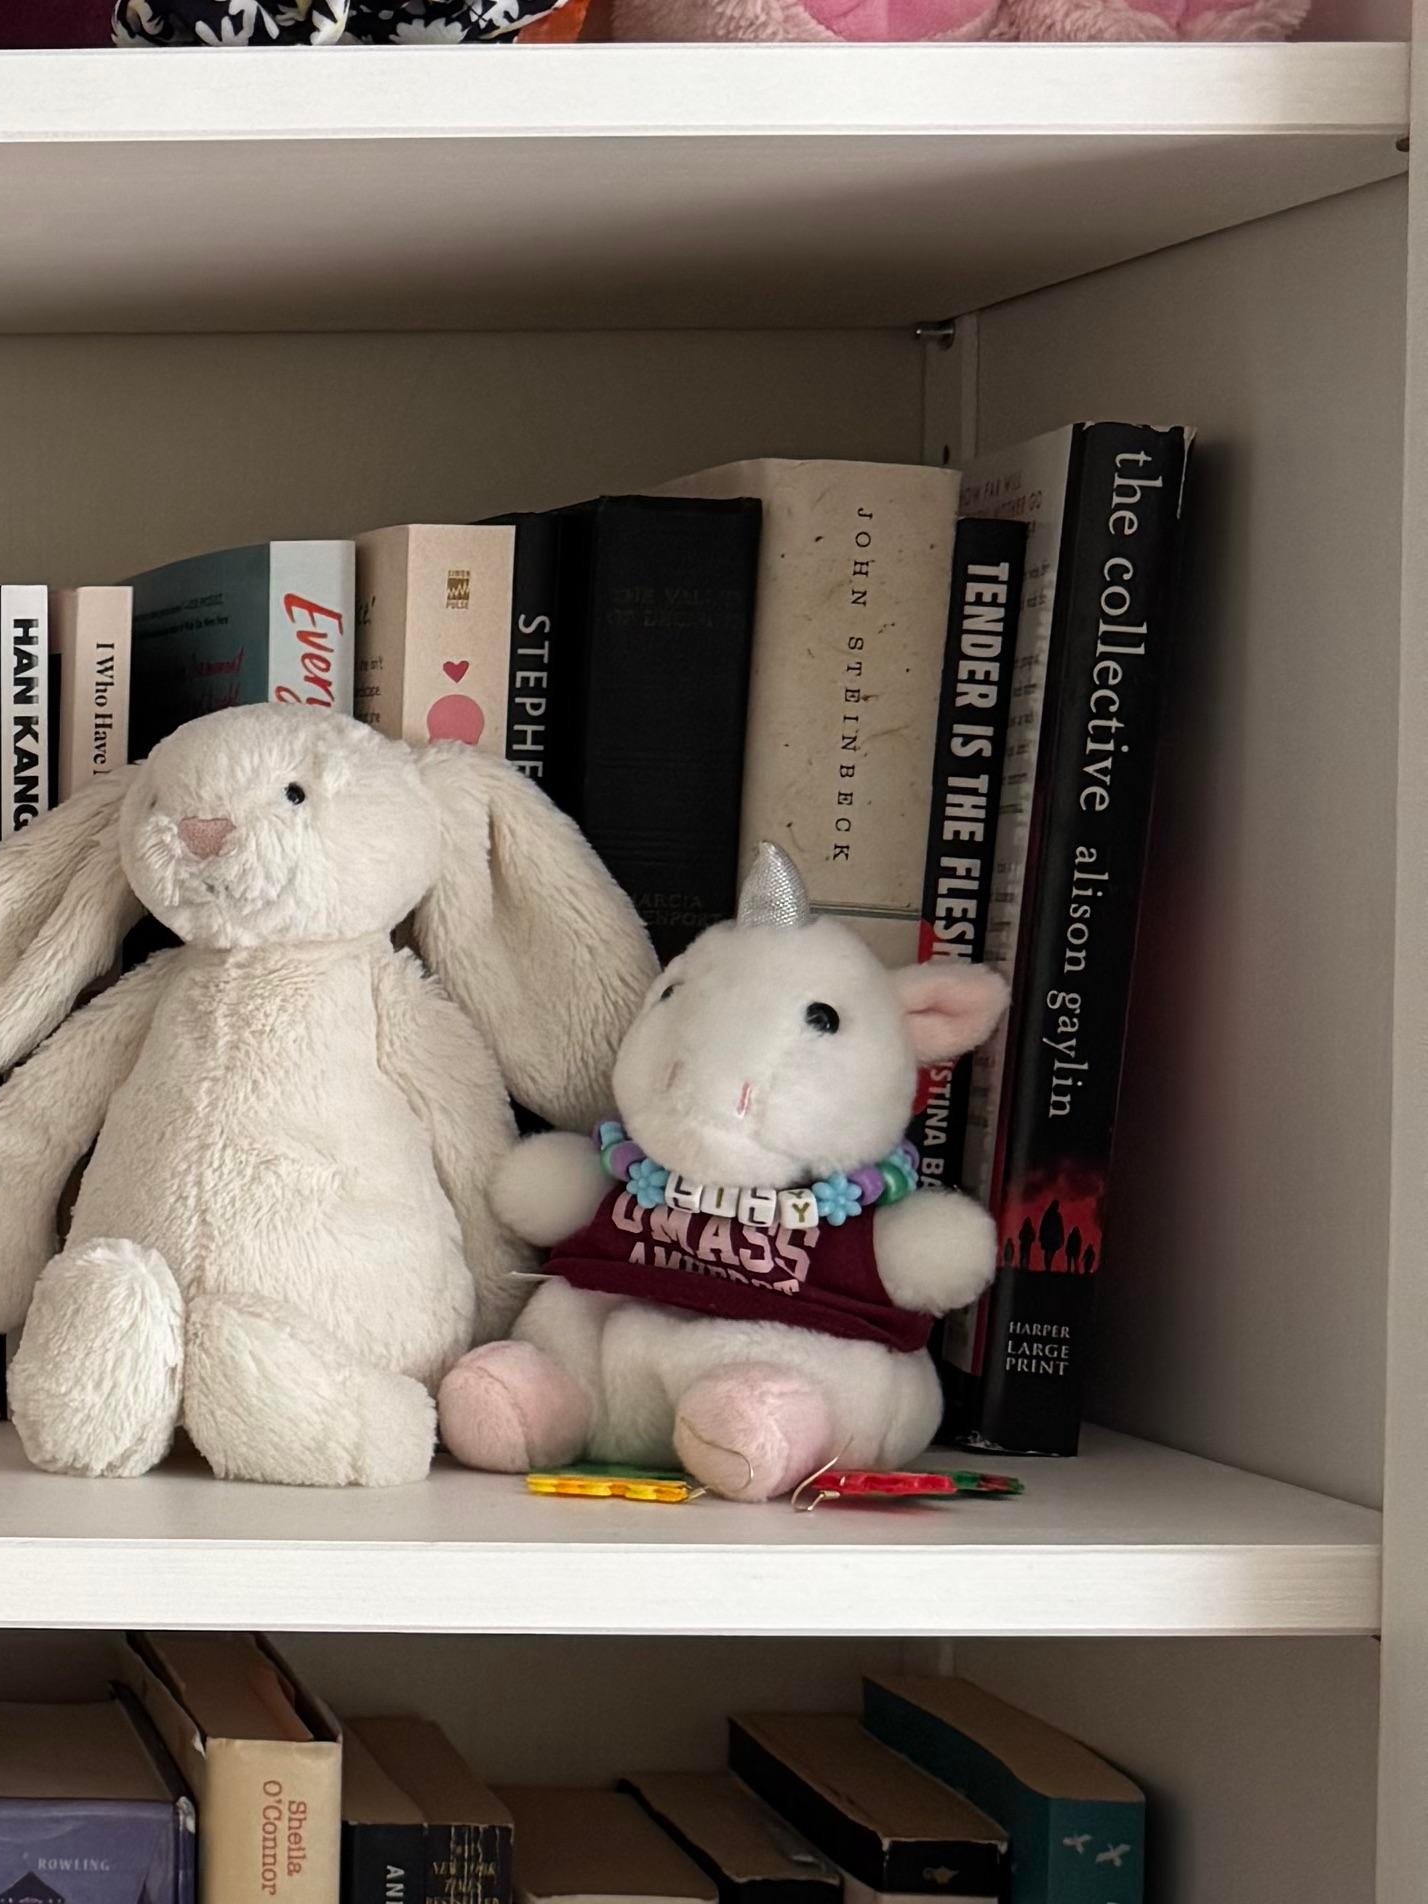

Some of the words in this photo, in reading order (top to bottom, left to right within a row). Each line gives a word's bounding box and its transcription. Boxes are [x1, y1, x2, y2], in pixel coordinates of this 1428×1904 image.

[1108, 451, 1163, 537] the
[850, 507, 873, 605] JOHN
[12, 619, 39, 705] HAN
[1078, 557, 1148, 814] collective
[833, 637, 865, 862] STEINBECK
[1005, 1358, 1069, 1376] PRINT
[1007, 1341, 1070, 1360] LARGE
[1008, 1322, 1070, 1339] HARPER
[261, 1780, 280, 1896] O'Connor
[287, 1800, 307, 1877] Sheila
